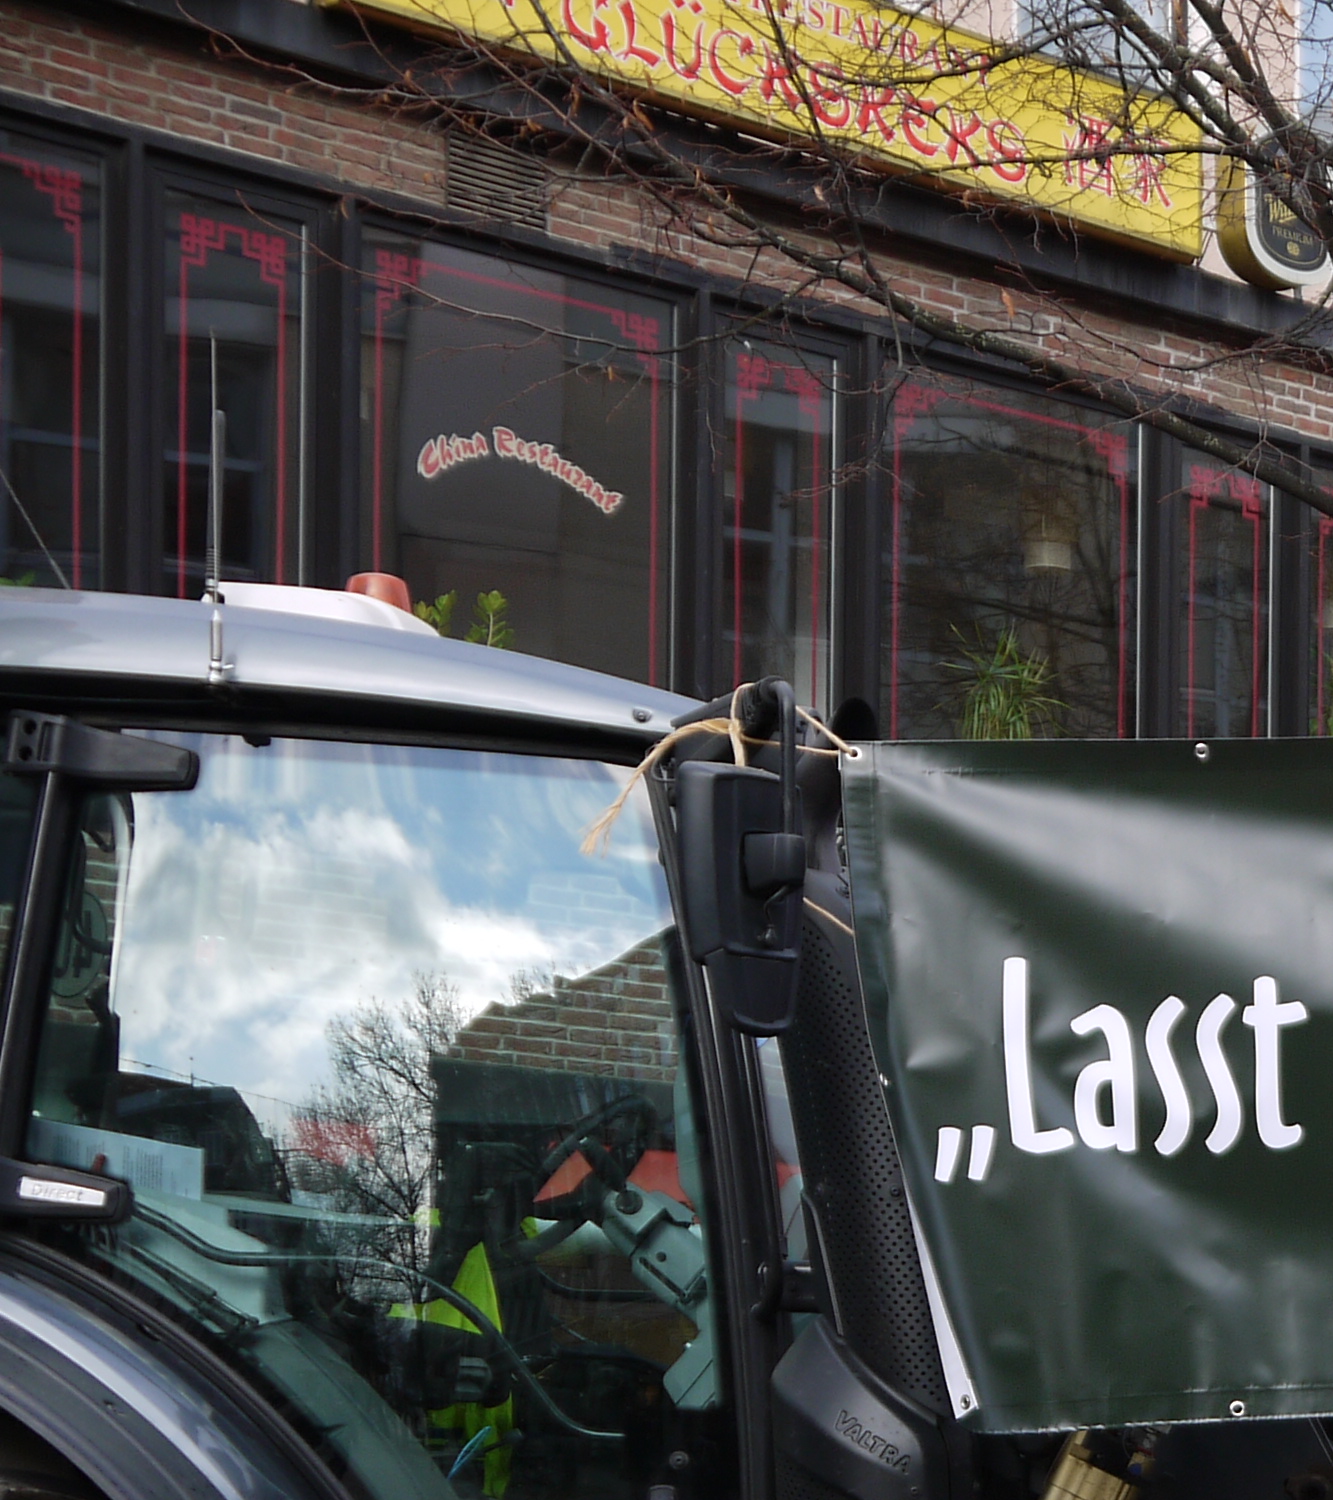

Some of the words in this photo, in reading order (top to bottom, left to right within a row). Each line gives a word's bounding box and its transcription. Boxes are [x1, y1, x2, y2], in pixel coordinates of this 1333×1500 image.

[418, 431, 490, 479] China
[493, 425, 624, 514] Restaurant
[31, 1184, 84, 1201] Direct
[835, 1409, 911, 1476] VALTRA
